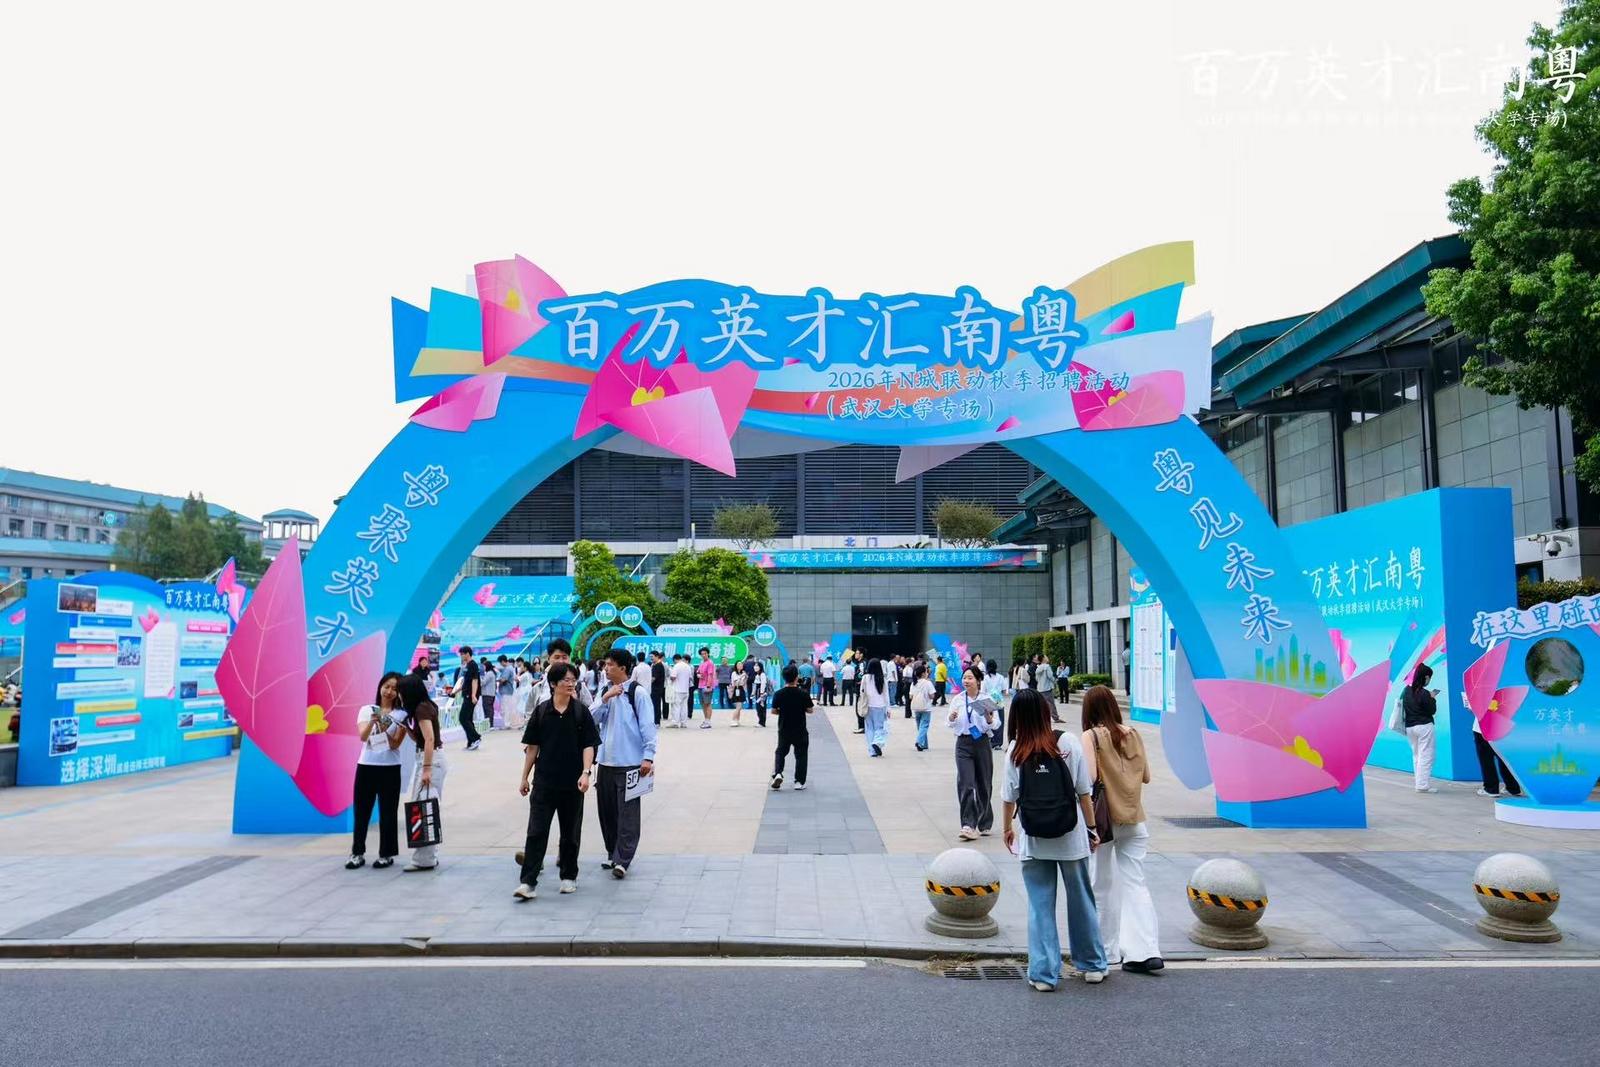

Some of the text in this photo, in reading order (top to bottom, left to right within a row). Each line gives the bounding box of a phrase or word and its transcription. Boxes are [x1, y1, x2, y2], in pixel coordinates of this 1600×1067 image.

[545, 292, 1081, 368] 百万英才汇南粤
[827, 369, 1130, 392] 2026年N城联动秋季招聘活动
[826, 396, 995, 421] （武汉大学专场）
[844, 536, 878, 547] 北门
[1153, 448, 1292, 644] 粤见未来
[307, 465, 450, 658] 粤聚英才
[778, 551, 854, 564] 百万英才汇南粤
[1302, 546, 1425, 599] 万英才汇南粤
[165, 588, 228, 612] 百万英才汇南粤
